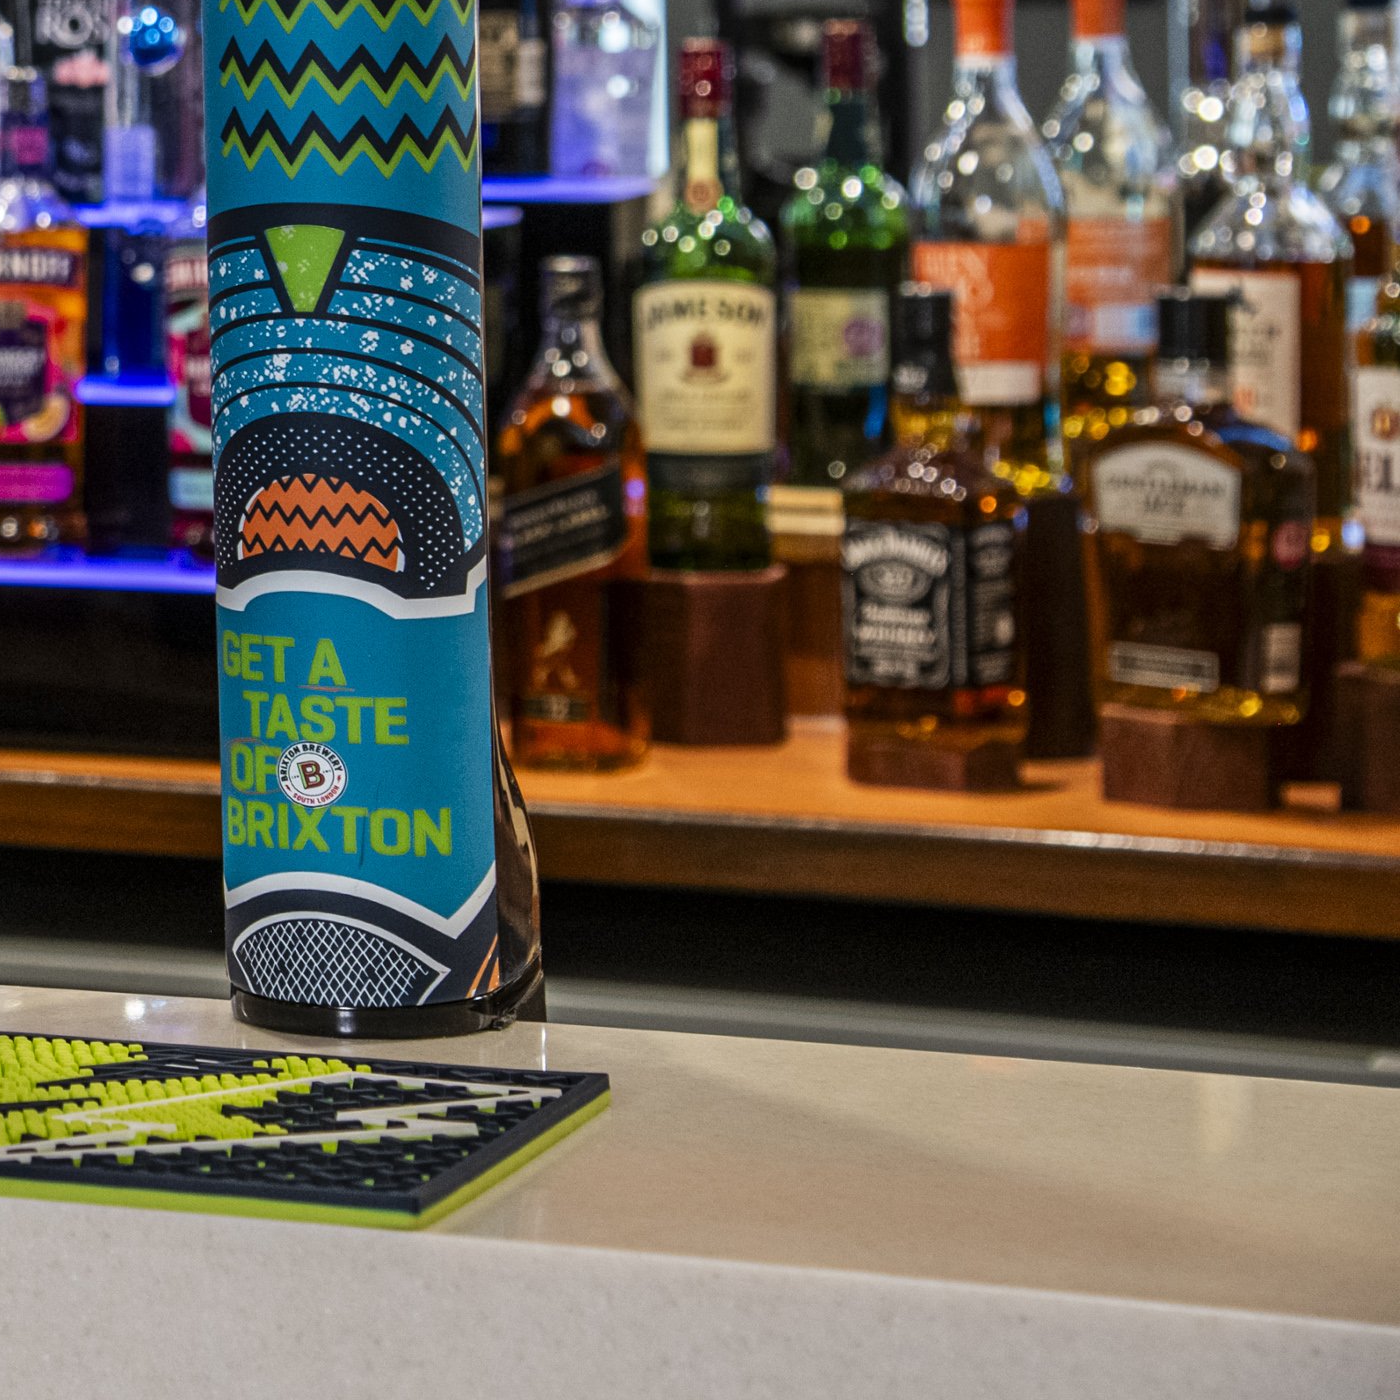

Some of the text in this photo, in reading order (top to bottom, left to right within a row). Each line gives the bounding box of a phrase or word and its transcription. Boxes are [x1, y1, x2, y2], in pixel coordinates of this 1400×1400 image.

[222, 629, 347, 686] GET A
[242, 690, 409, 745] TASTE
[230, 742, 282, 793] OF
[280, 743, 344, 782] BRIXTON BREWERY
[293, 785, 340, 805] SOUTH LONDON
[227, 796, 453, 857] BRIXTON
